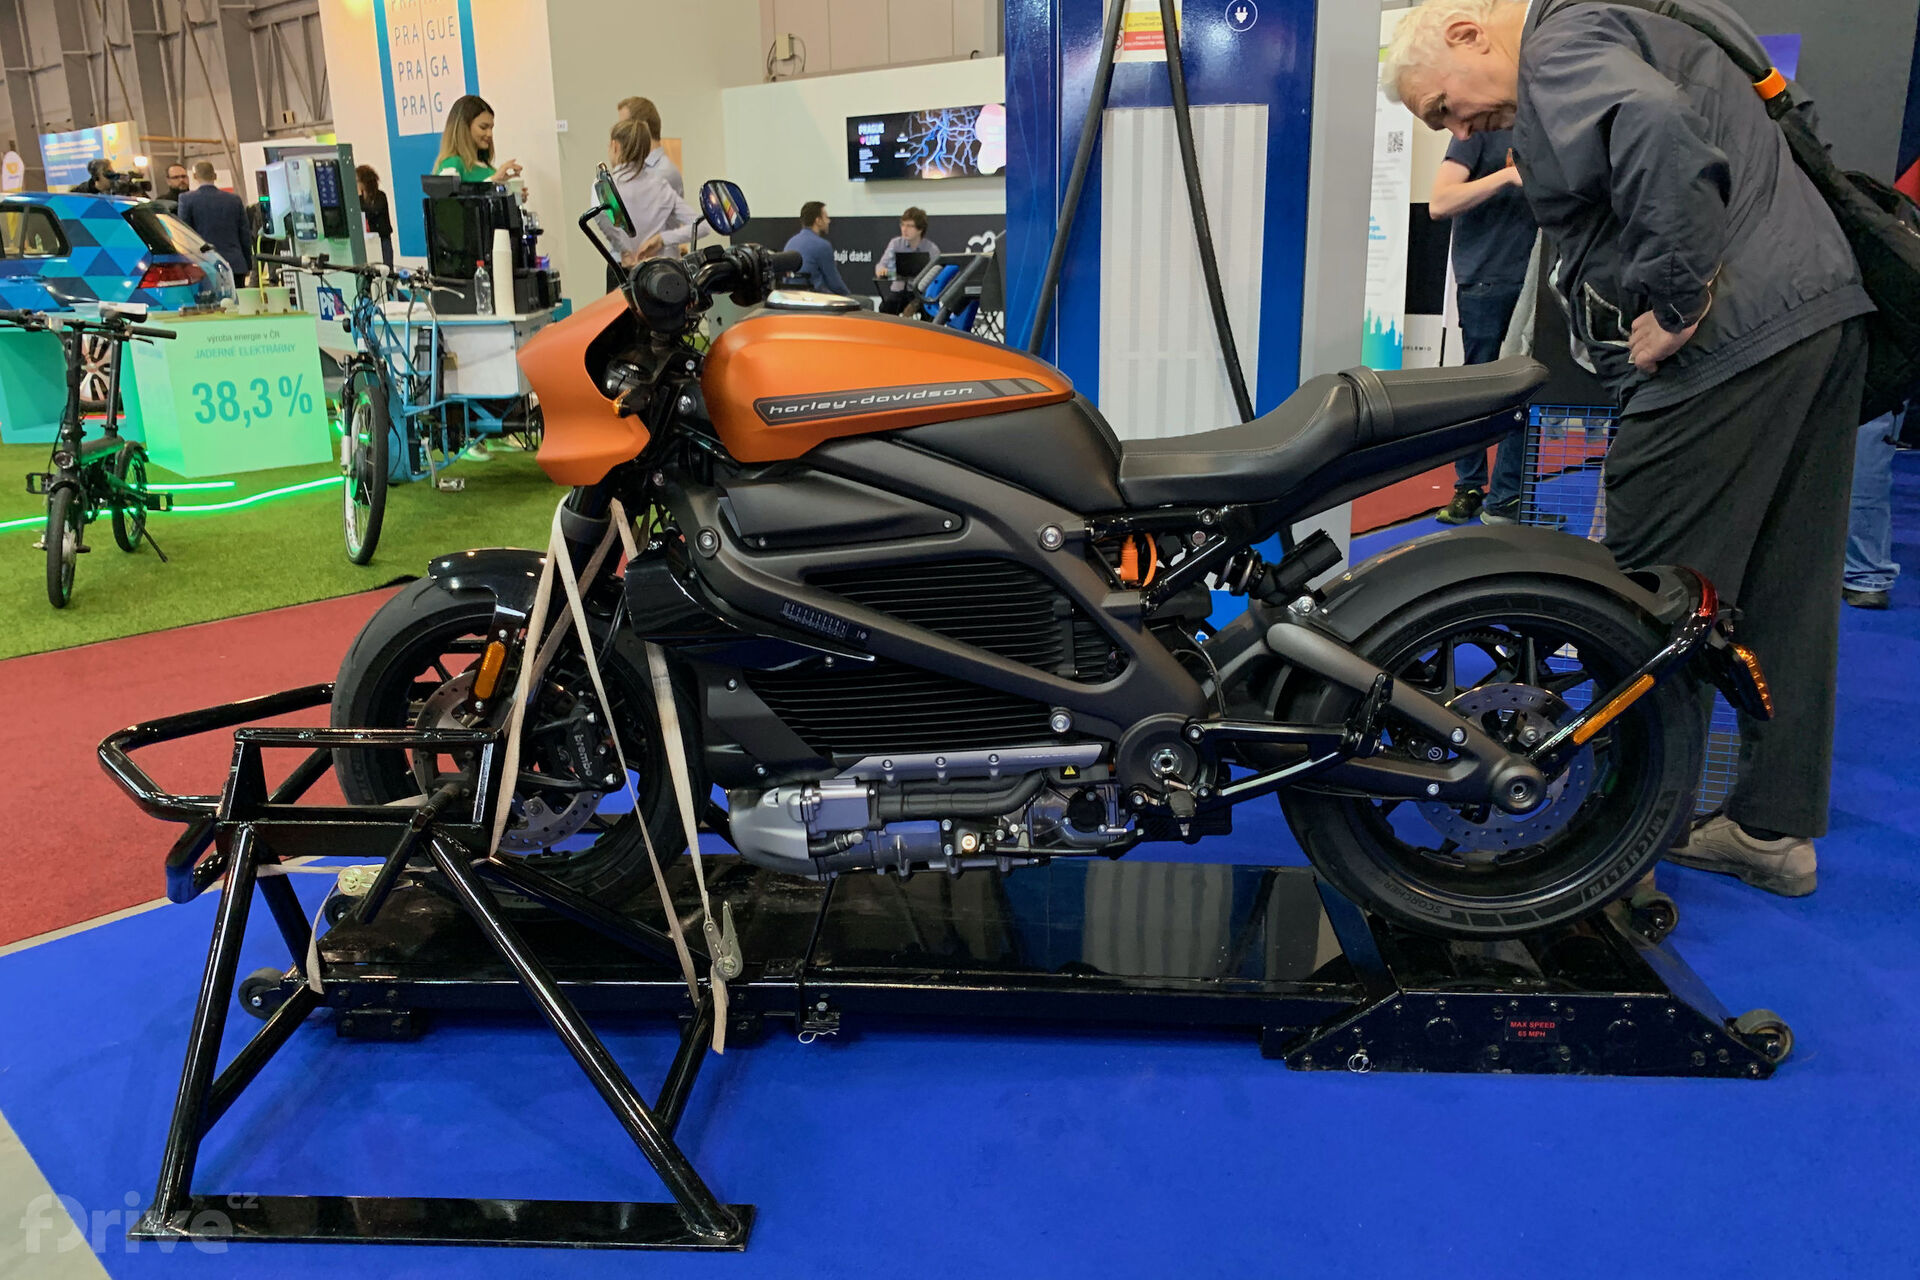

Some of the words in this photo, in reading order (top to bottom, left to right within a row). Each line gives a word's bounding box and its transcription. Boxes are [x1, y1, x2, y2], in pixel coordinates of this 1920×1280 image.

[207, 335, 232, 344] výroba
[234, 333, 262, 342] energie
[192, 378, 273, 429] 38,3
[278, 373, 313, 417] %
[769, 387, 973, 415] harley-davidson
[574, 734, 593, 777] brembo
[1589, 815, 1665, 898] MICHELIN
[1529, 1021, 1556, 1029] SPEED
